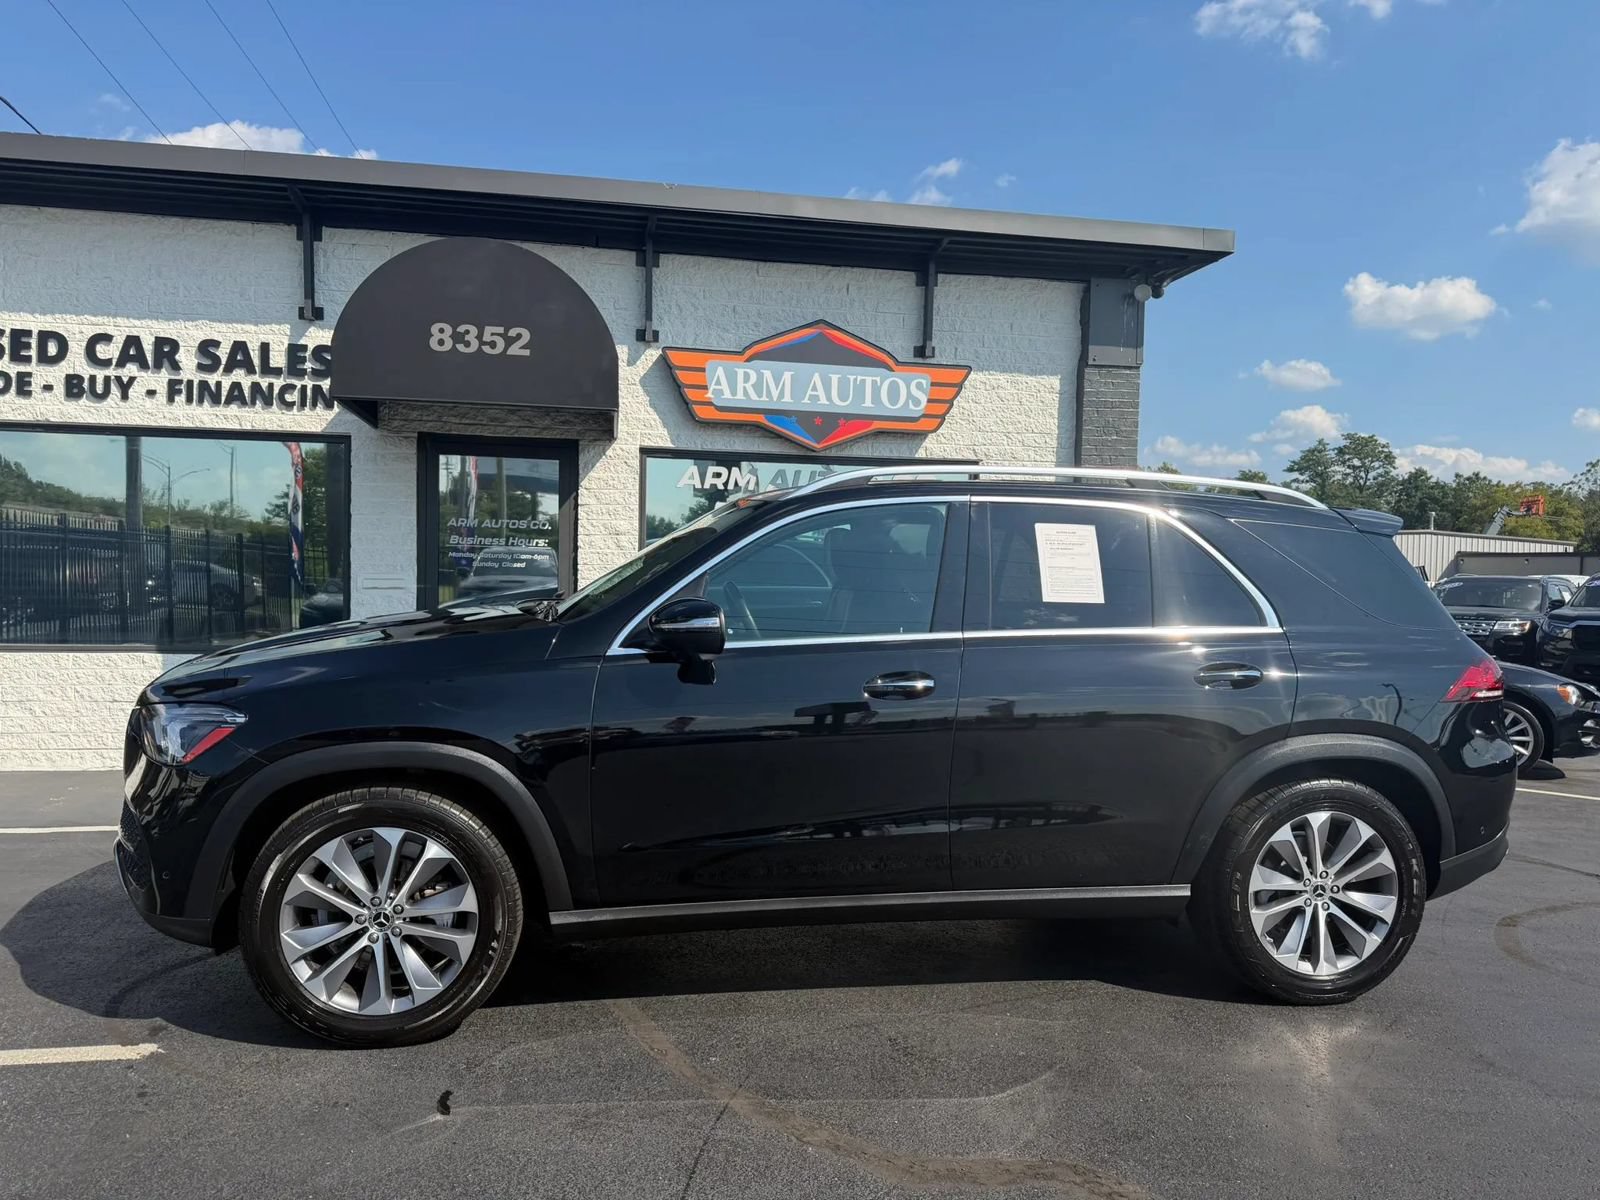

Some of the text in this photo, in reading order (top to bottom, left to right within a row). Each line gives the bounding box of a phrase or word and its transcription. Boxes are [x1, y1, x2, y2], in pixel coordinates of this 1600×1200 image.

[0, 328, 331, 378] ED CAR SALES
[429, 322, 531, 356] 8352
[65, 373, 137, 401] BUY
[705, 366, 929, 411] ARM AUTOS
[676, 465, 757, 490] ARM
[447, 518, 552, 530] ARM AUTOS CO.
[449, 535, 549, 547] Business Hours:
